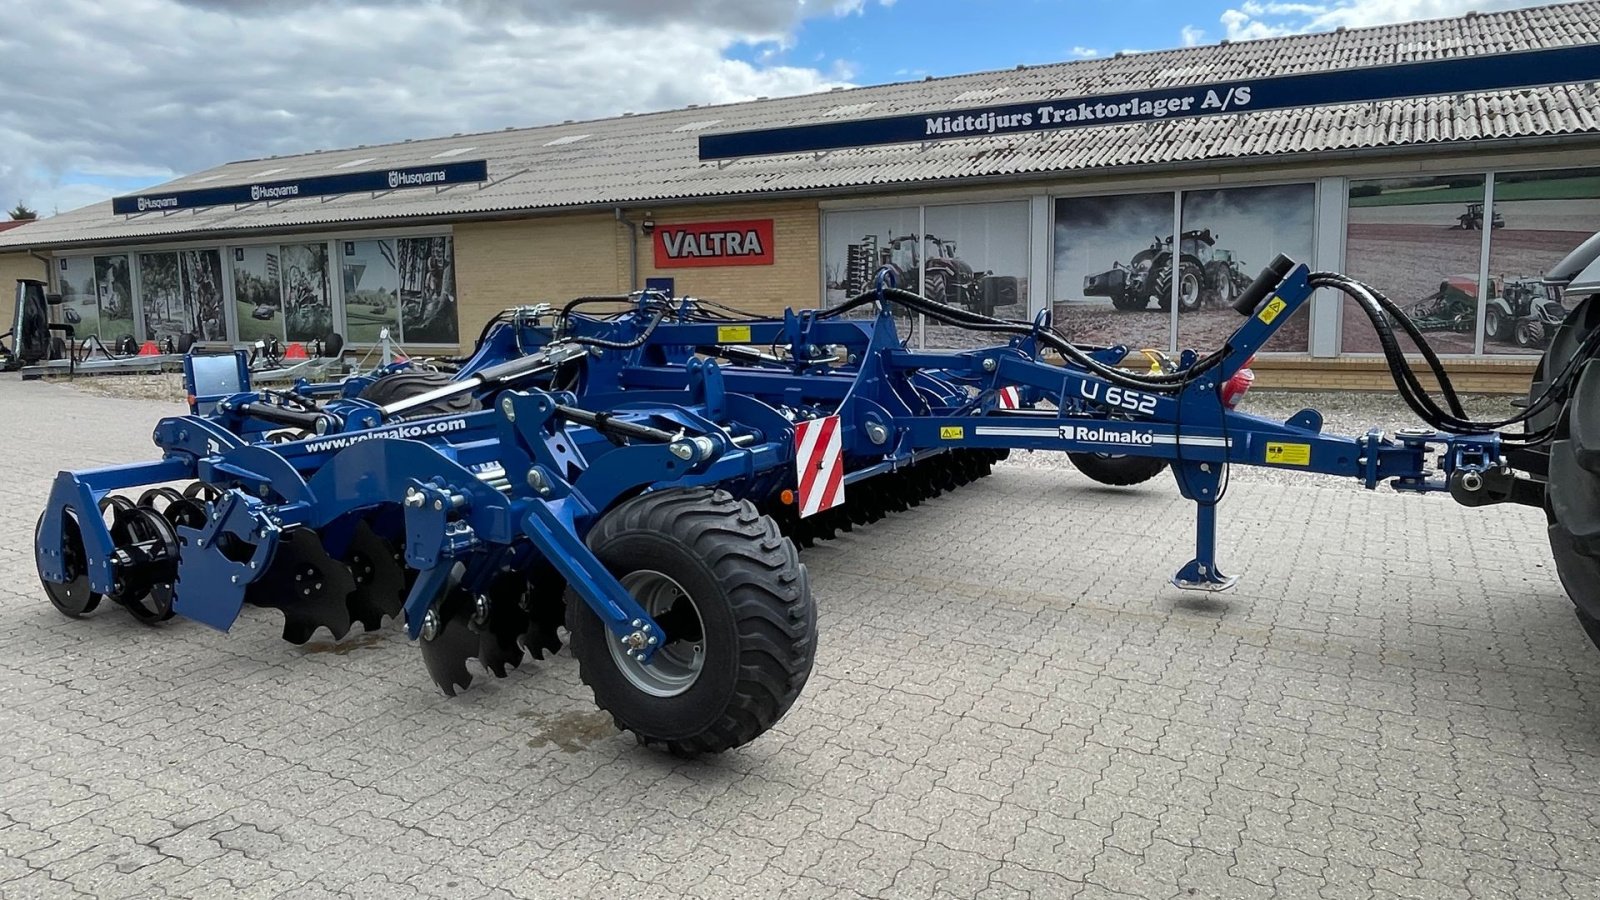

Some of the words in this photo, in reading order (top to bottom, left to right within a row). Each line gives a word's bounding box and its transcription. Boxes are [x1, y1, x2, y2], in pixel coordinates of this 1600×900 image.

[925, 111, 1033, 135] Midtdjurs
[1037, 96, 1195, 124] Traktorlager
[1200, 86, 1252, 112] A/S
[398, 170, 446, 185] Husqvarna
[259, 184, 299, 198] Husqvarna
[144, 197, 178, 209] Husqvarna
[661, 230, 763, 258] VALTRA
[1080, 379, 1100, 400] U
[1105, 386, 1158, 415] 652
[1076, 426, 1153, 445] Rolmako
